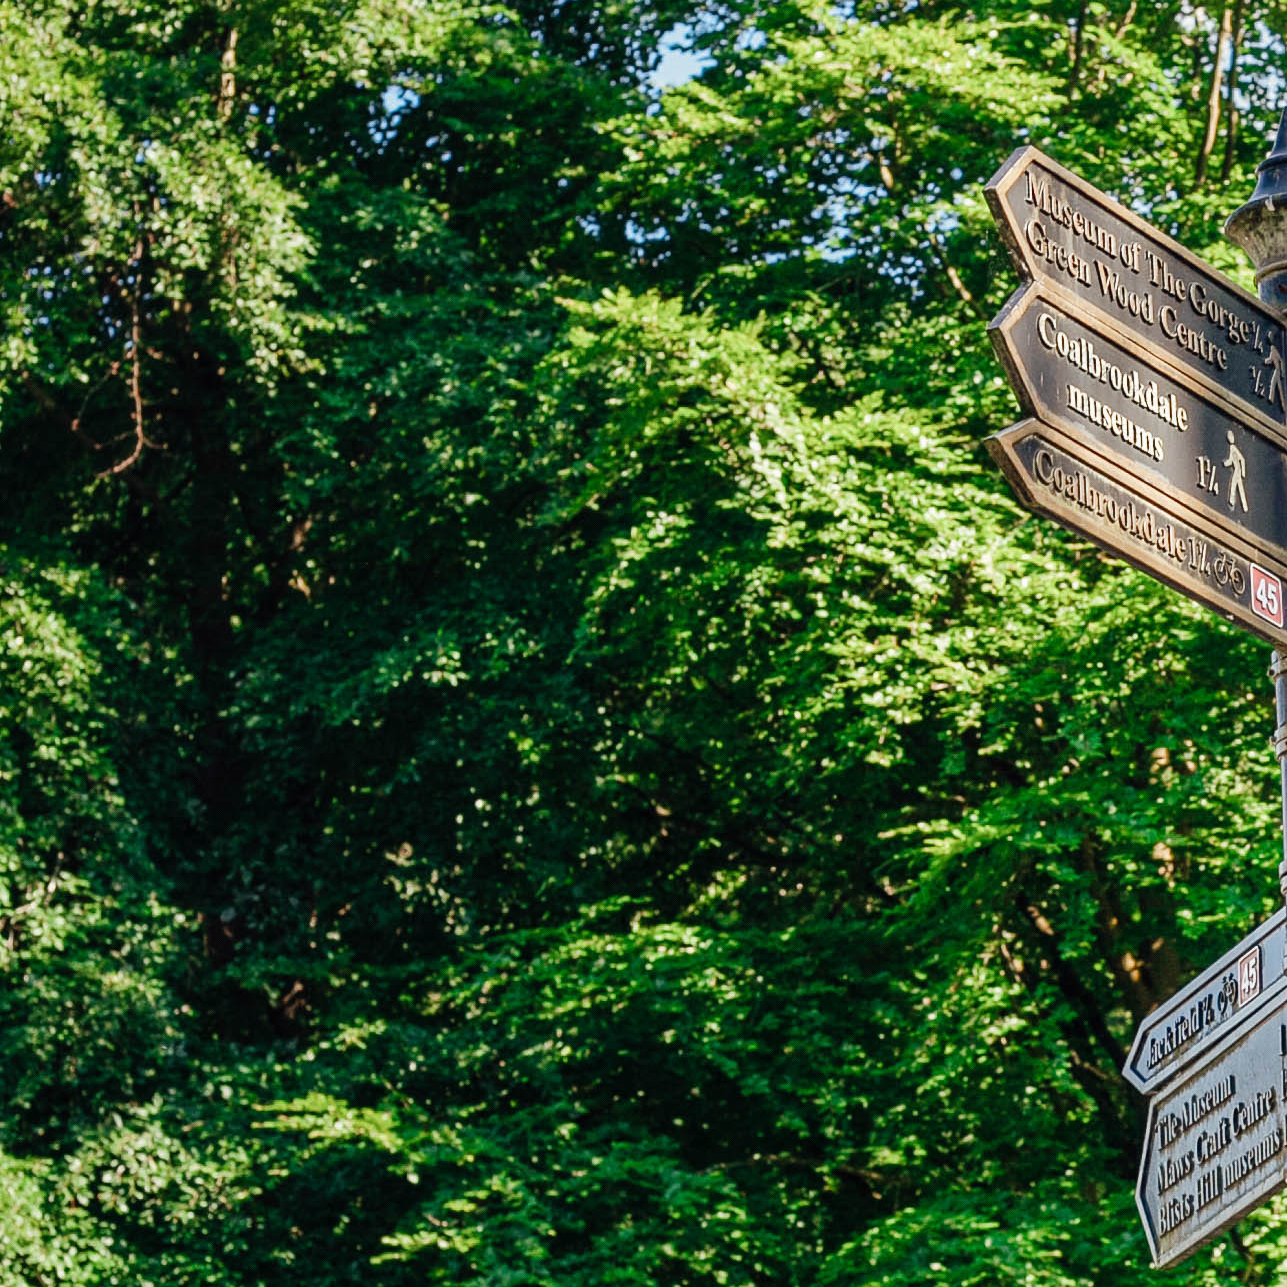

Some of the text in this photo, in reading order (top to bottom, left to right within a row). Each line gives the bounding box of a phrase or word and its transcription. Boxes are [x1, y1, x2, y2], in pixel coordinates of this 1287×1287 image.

[1024, 171, 1118, 258] Museum
[1120, 240, 1141, 273] of
[1145, 249, 1187, 301] The
[1190, 280, 1250, 344] Gorge
[1026, 219, 1092, 287] Green
[1094, 260, 1155, 326] Wood
[1160, 305, 1229, 371] Centre
[1037, 312, 1190, 432] Coalbrookdale
[1066, 383, 1165, 463] museums
[1033, 449, 1187, 563] Coalbrookdale
[1256, 577, 1279, 616] 45
[1146, 999, 1204, 1071] Jackfield
[1240, 957, 1258, 994] 45
[1154, 1115, 1182, 1151] Tile
[1181, 1074, 1237, 1133] Museum
[1157, 1150, 1194, 1196] Maws
[1195, 1115, 1232, 1165] Craft
[1232, 1085, 1277, 1139] Centre
[1158, 1193, 1195, 1238] Blists
[1195, 1164, 1223, 1213] Hill
[1222, 1126, 1283, 1192] museums
